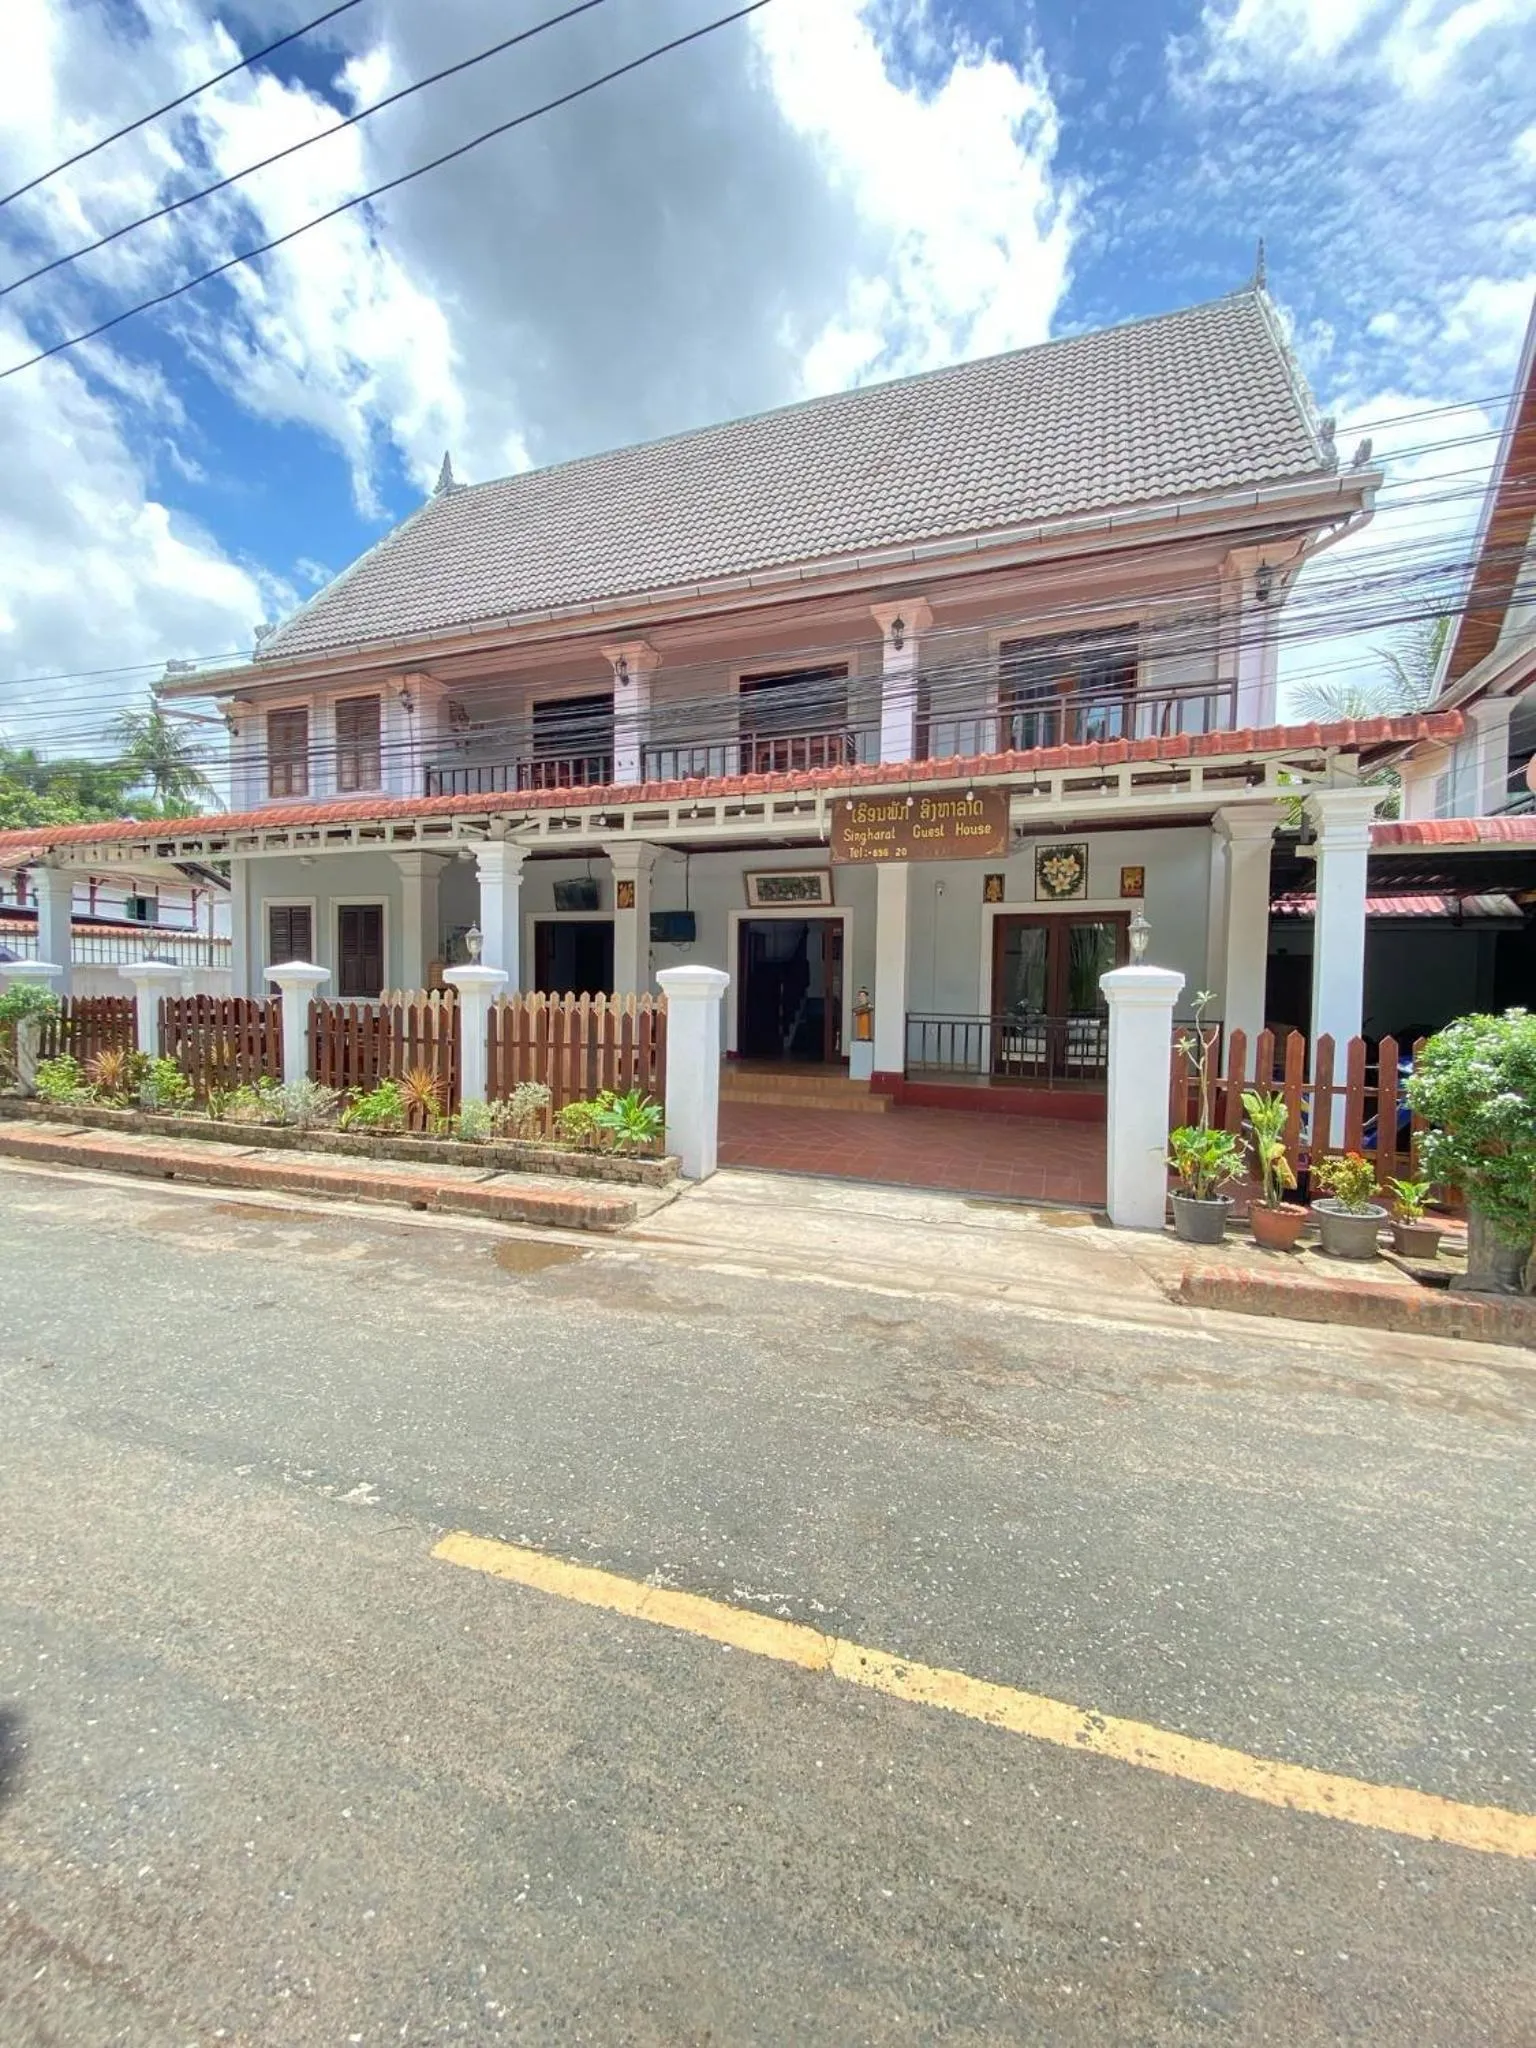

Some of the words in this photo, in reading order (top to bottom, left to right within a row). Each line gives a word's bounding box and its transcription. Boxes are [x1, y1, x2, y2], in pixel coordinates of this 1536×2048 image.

[843, 826, 896, 846] Singharat
[912, 823, 945, 839] Guest
[955, 821, 992, 837] House
